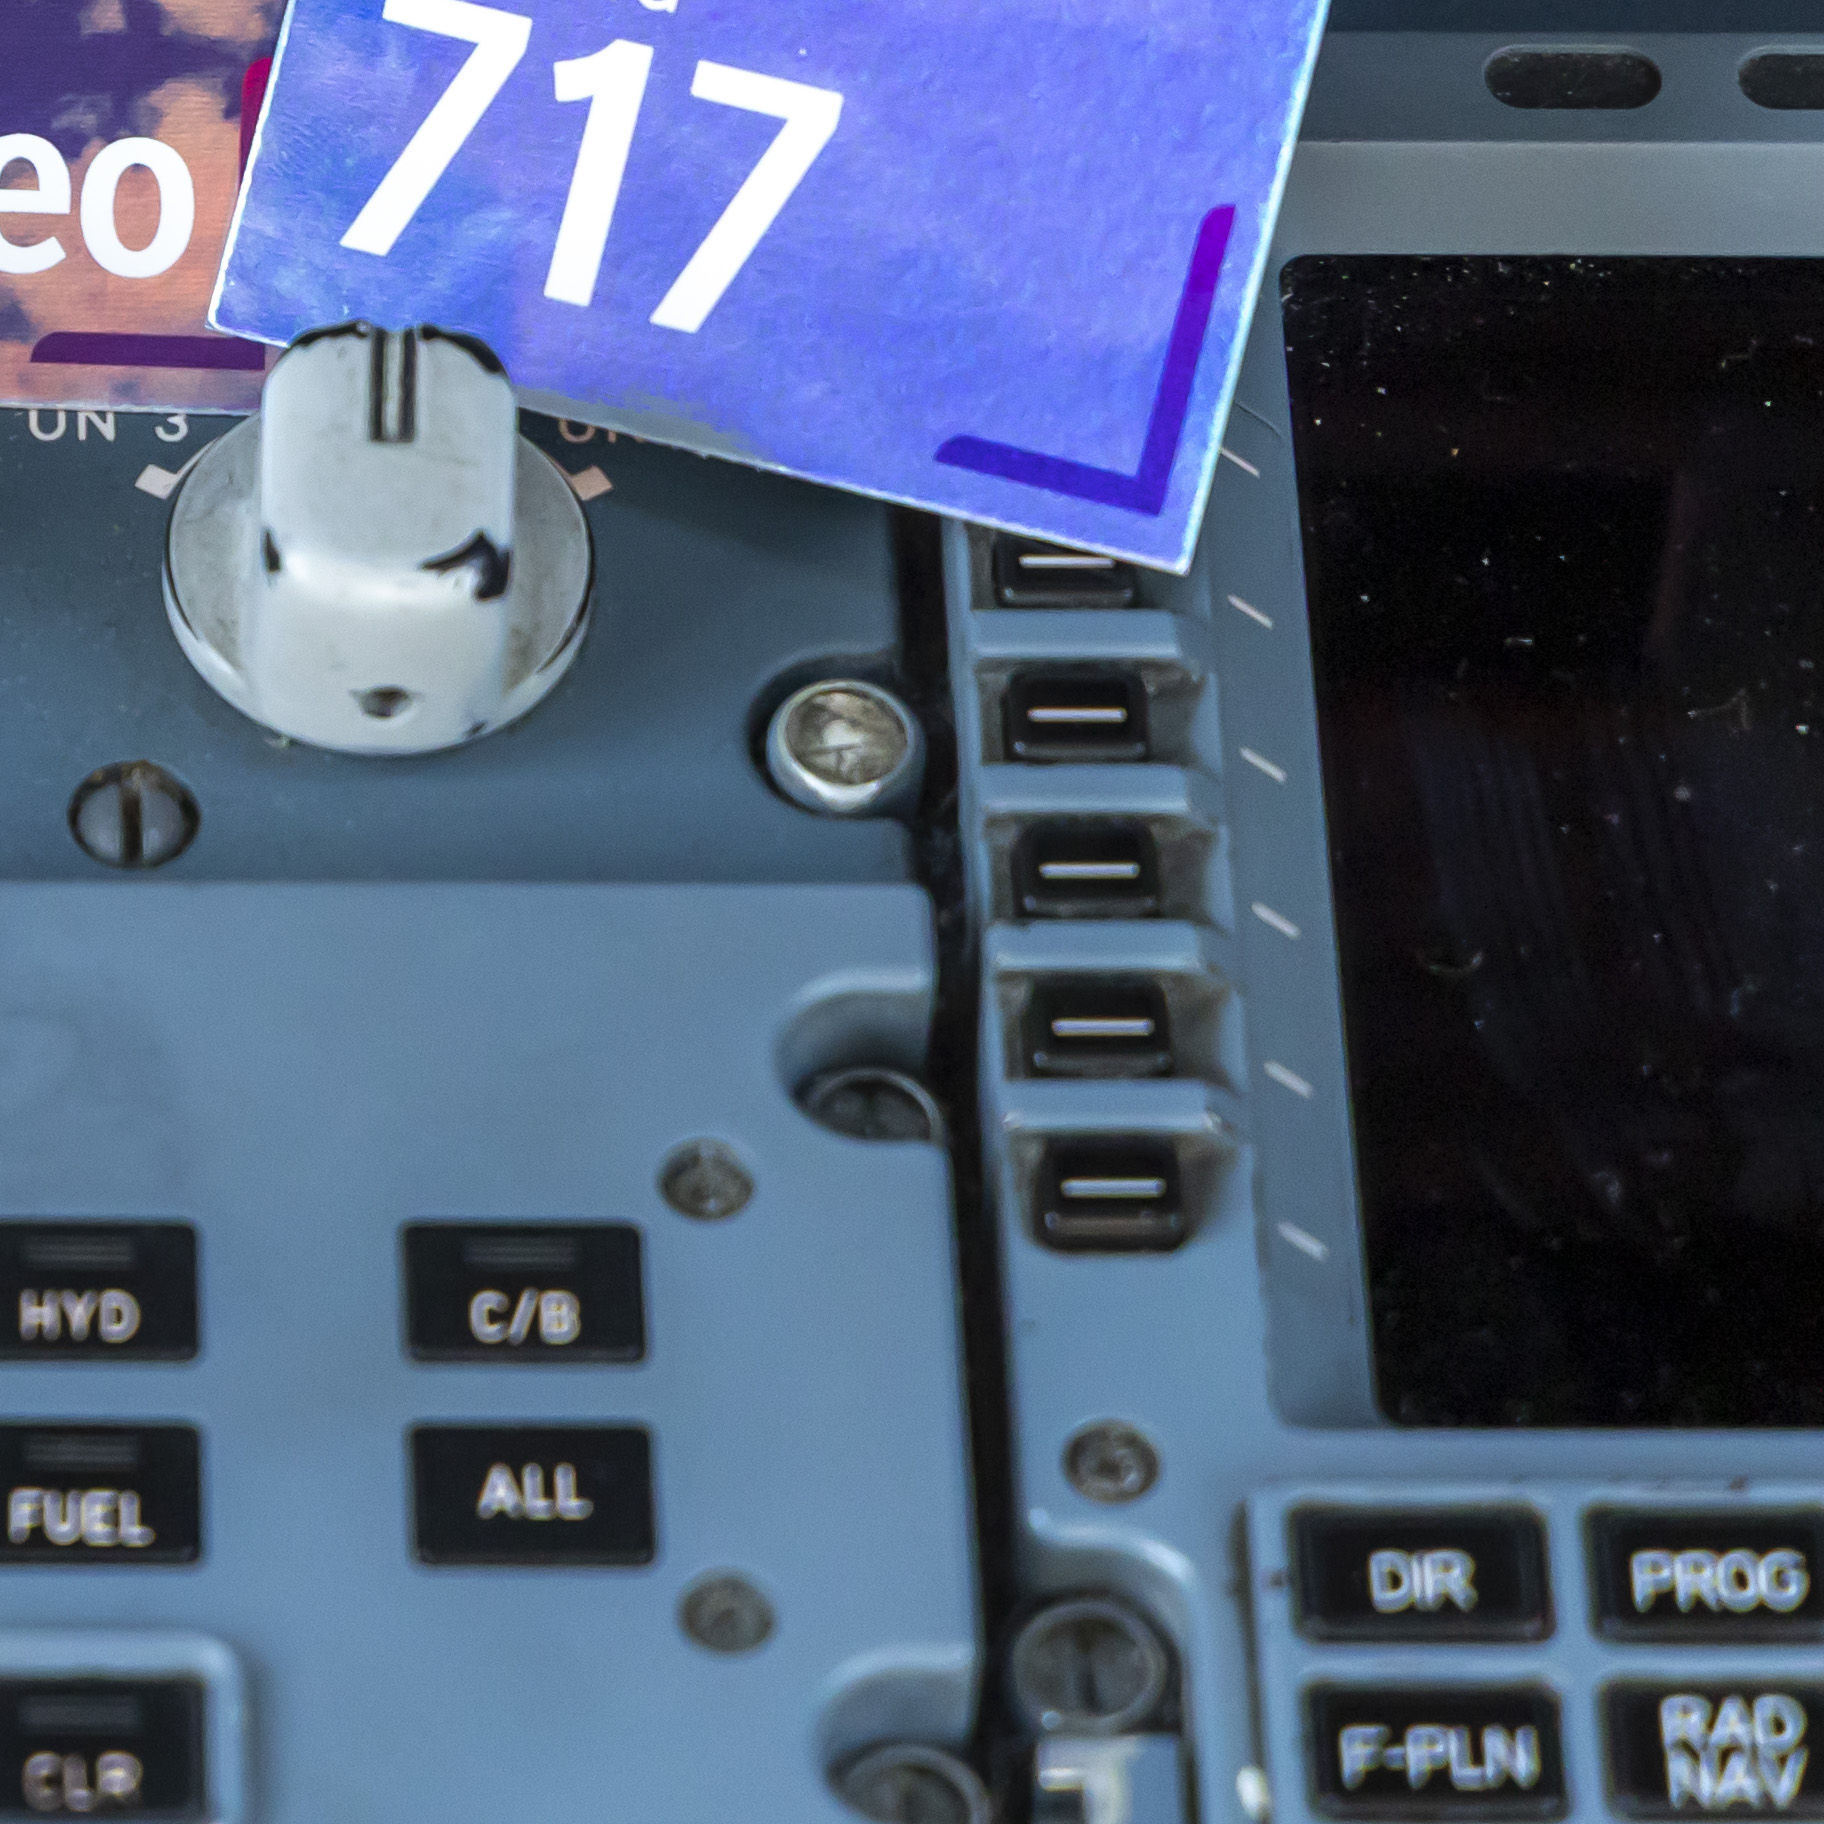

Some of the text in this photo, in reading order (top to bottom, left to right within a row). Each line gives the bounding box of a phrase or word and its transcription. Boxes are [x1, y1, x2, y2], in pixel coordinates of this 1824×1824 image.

[27, 409, 115, 442] ON
[18, 1289, 140, 1344] HYD
[468, 1289, 581, 1345] C/B
[8, 1490, 155, 1548] FUEL
[475, 1463, 593, 1521] ALL
[1368, 1548, 1477, 1613] DIR
[1630, 1549, 1809, 1613] PROG
[1659, 1694, 1808, 1758] RAD
[21, 1751, 142, 1813] CLR
[1339, 1724, 1539, 1791] F-PLN
[1664, 1746, 1809, 1810] NAV
